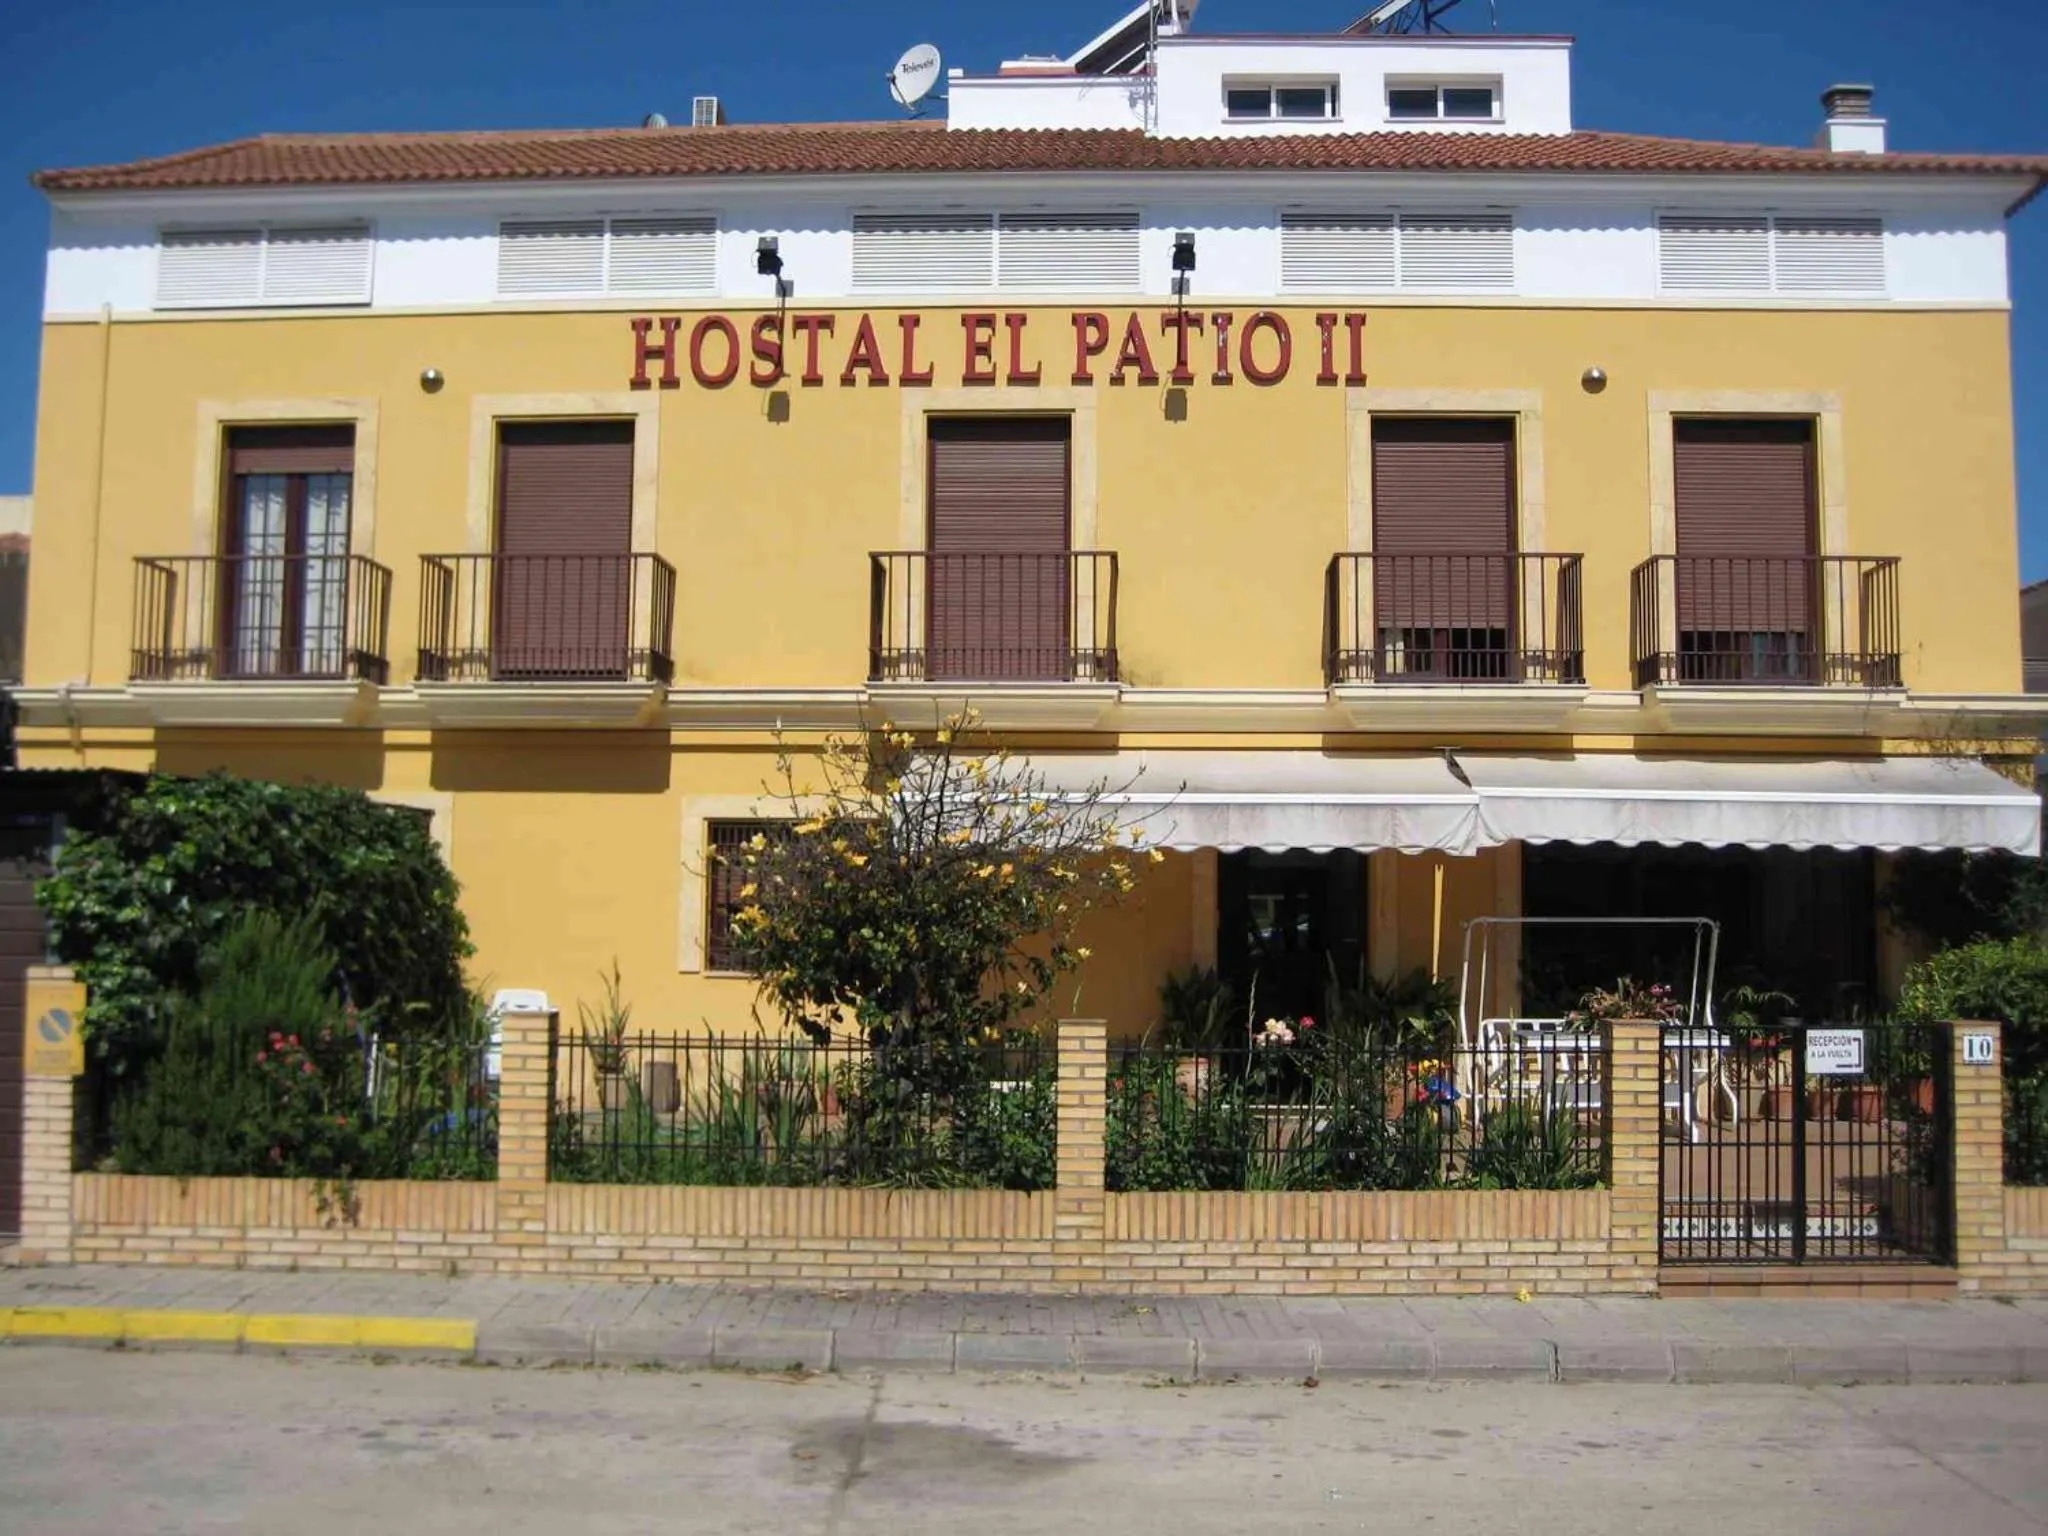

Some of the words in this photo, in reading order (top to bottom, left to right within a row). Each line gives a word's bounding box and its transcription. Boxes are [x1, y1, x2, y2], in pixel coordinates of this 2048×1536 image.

[630, 310, 934, 390] HOSTAL
[961, 312, 1042, 387] EL
[1070, 310, 1292, 387] PATIO
[1315, 312, 1367, 388] II
[1967, 1038, 1991, 1058] 10
